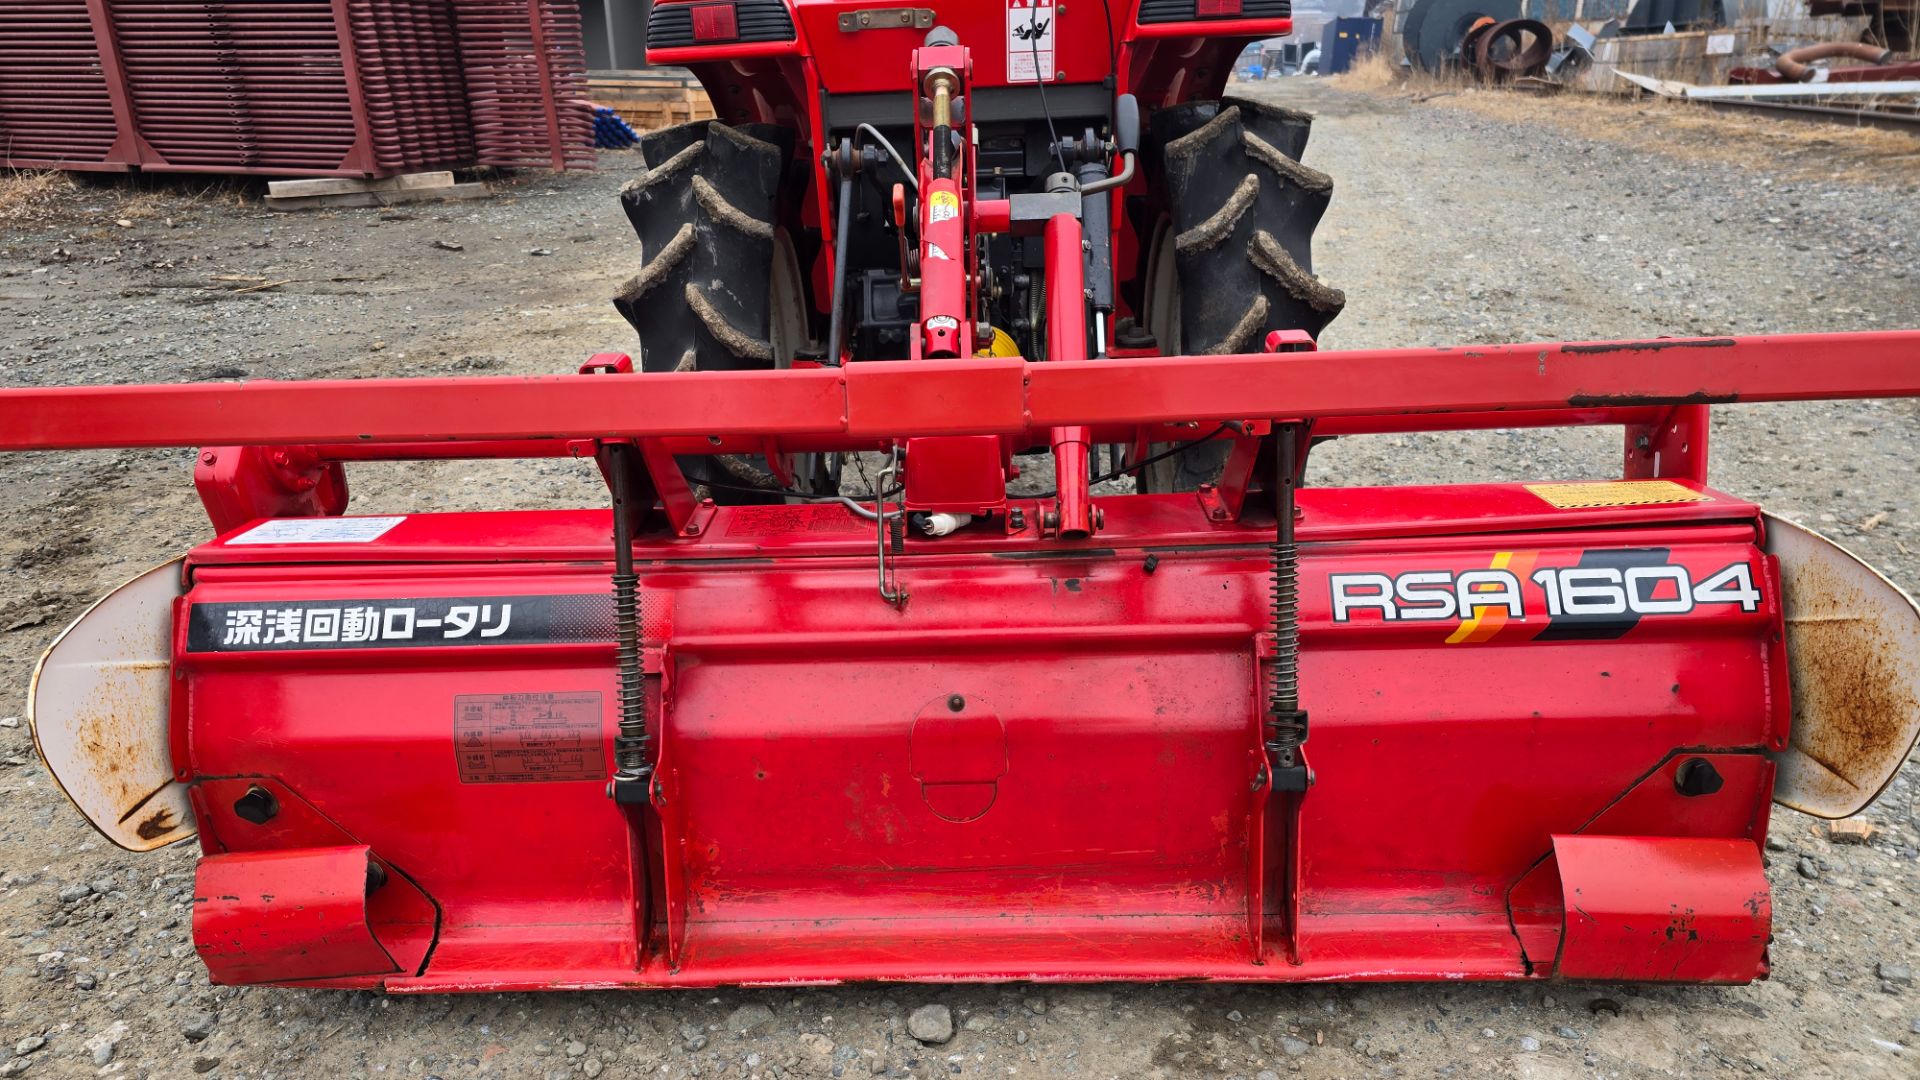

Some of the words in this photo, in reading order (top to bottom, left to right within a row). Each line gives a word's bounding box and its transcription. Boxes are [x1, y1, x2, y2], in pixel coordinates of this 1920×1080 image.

[223, 603, 512, 645] 深浅回動ロータリ
